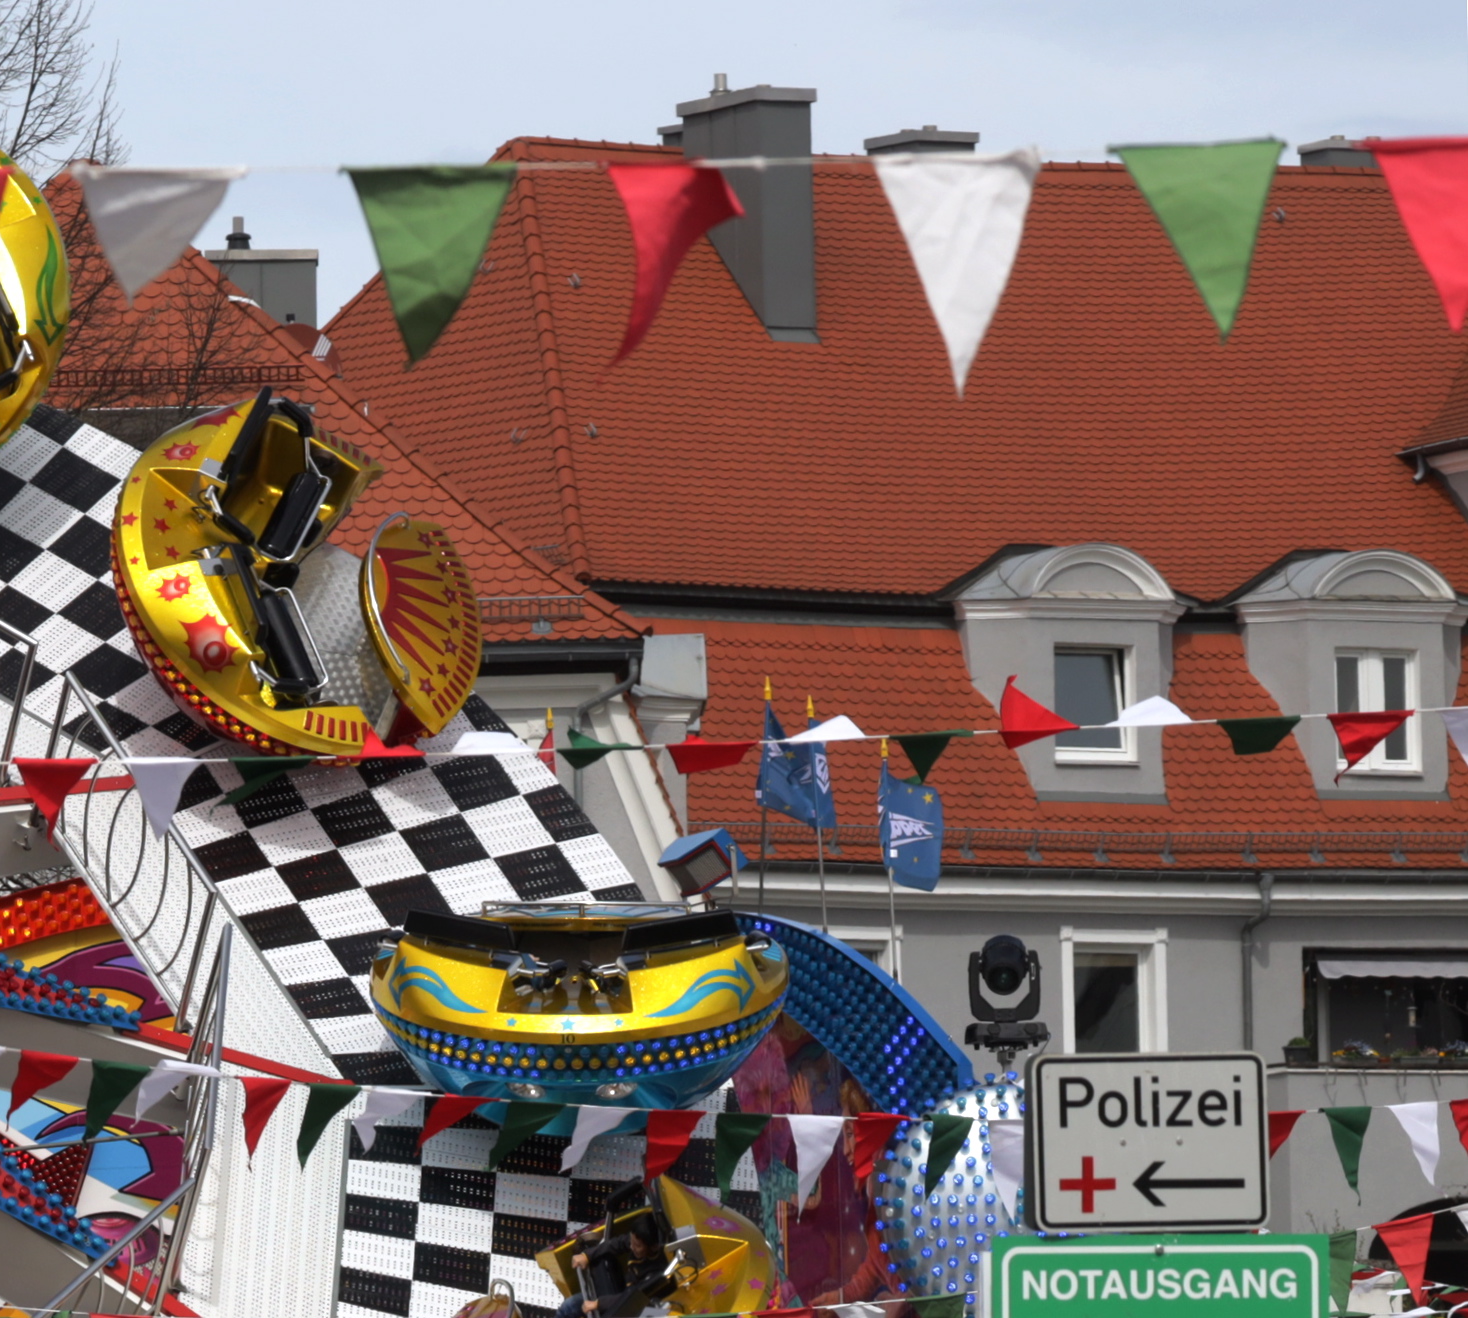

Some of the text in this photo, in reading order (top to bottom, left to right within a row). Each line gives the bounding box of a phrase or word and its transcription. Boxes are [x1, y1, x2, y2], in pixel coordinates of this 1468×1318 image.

[560, 1033, 576, 1045] 10
[1058, 1074, 1243, 1128] Polizei
[1021, 1268, 1298, 1301] NOTAUSGANG
